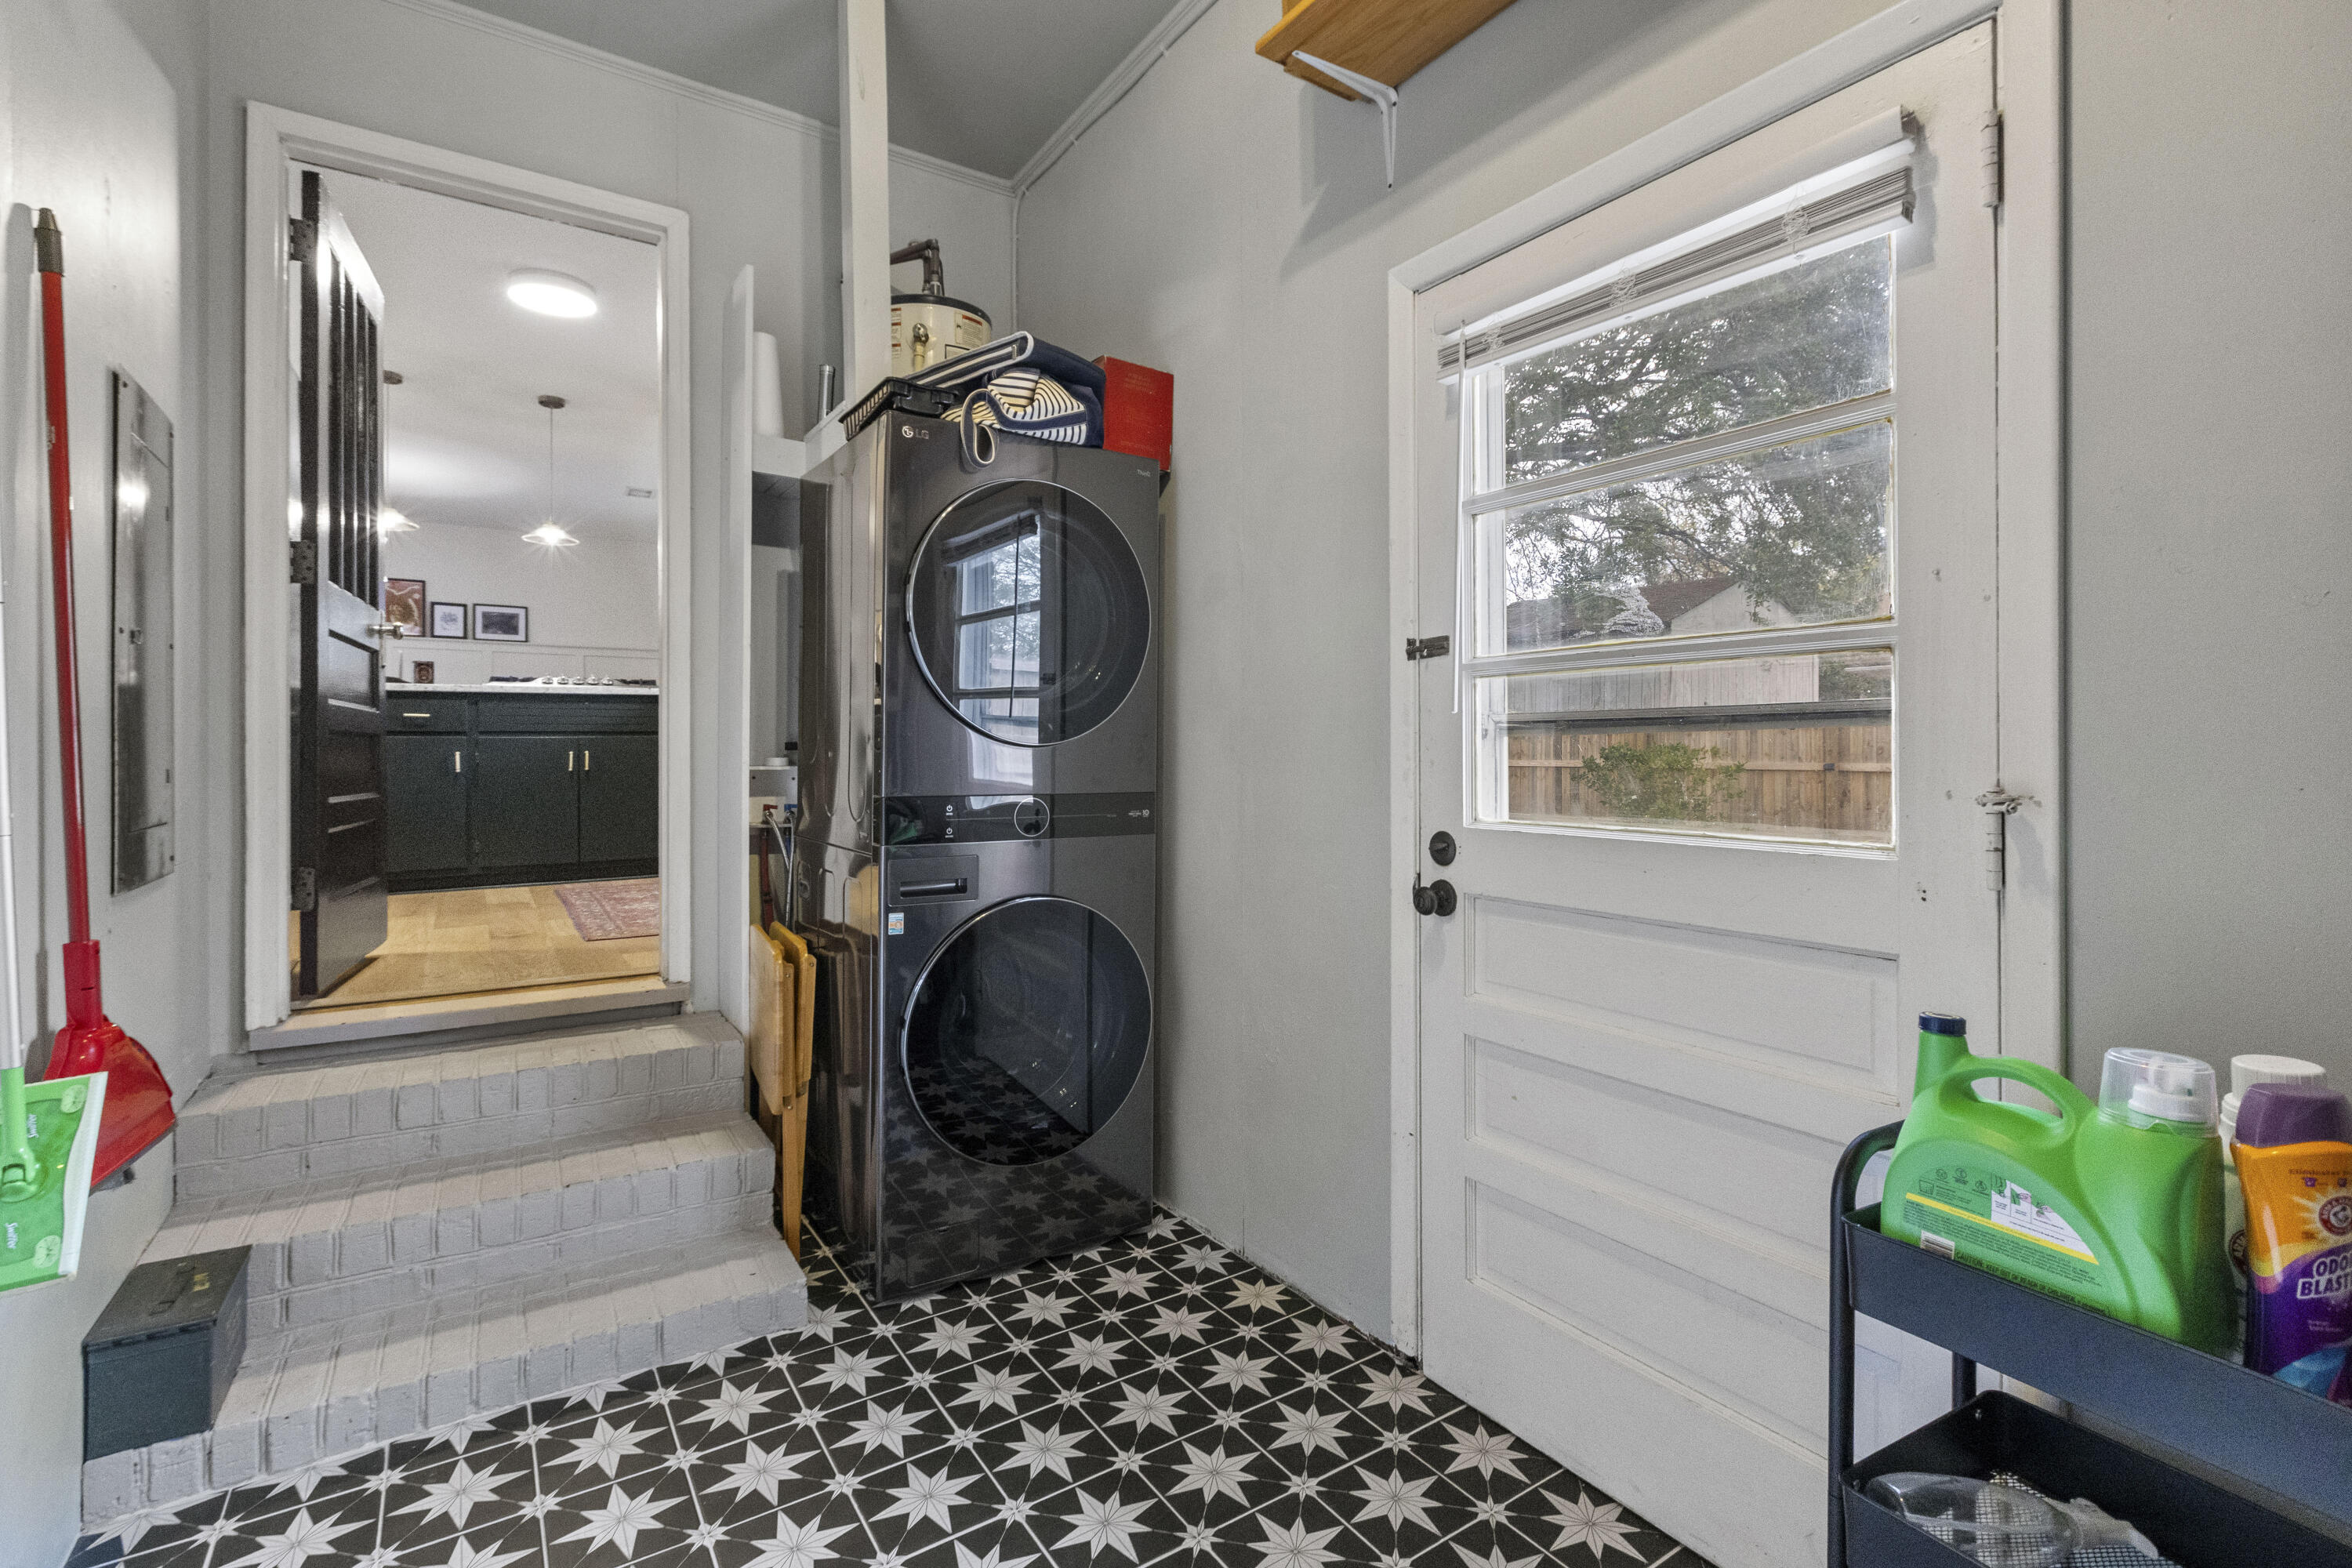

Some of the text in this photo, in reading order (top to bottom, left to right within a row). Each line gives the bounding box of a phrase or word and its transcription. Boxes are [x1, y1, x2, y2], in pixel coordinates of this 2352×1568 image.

[5, 1222, 19, 1250] Swiffer
[2314, 1253, 2352, 1277] ODO
[2297, 1270, 2352, 1299] BLAST
